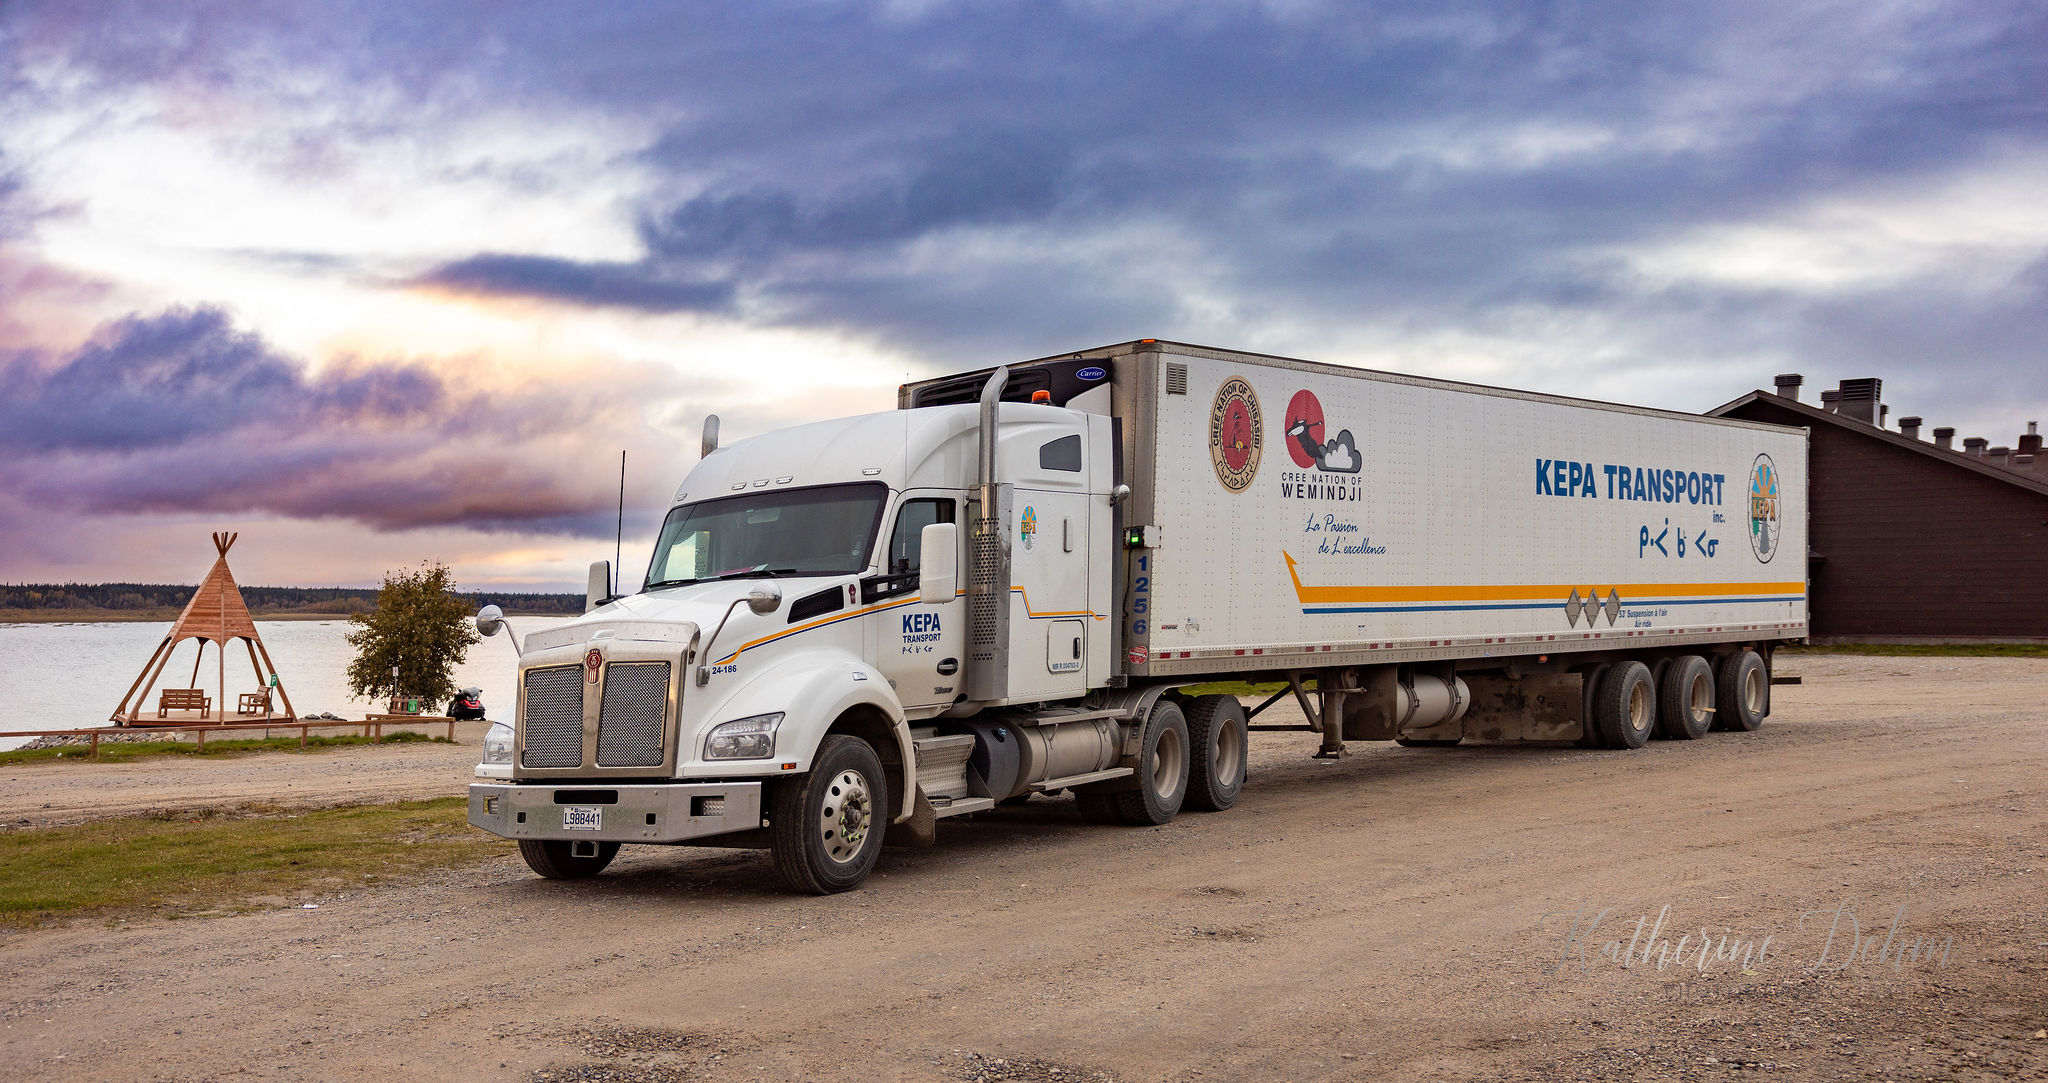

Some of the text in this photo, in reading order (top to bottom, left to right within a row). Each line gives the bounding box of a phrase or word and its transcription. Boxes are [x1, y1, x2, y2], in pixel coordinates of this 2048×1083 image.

[1213, 382, 1261, 449] CREE NATION OF CHISASIBI
[1281, 472, 1362, 486] CREE NATION OF
[1535, 458, 1725, 506] KEPA TRANSPORT
[1281, 483, 1362, 502] WEMINDJI
[1712, 510, 1726, 524] inc.
[1752, 499, 1776, 521] KEPA
[1021, 522, 1037, 534] KEPA
[1304, 512, 1359, 533] La Passion
[1317, 535, 1387, 556] de L'excellence
[1627, 609, 1654, 619] Suspension
[902, 613, 942, 634] KEPA
[902, 633, 942, 644] TRANSPORT
[712, 664, 737, 675] 24-186
[564, 812, 600, 825] L988441
